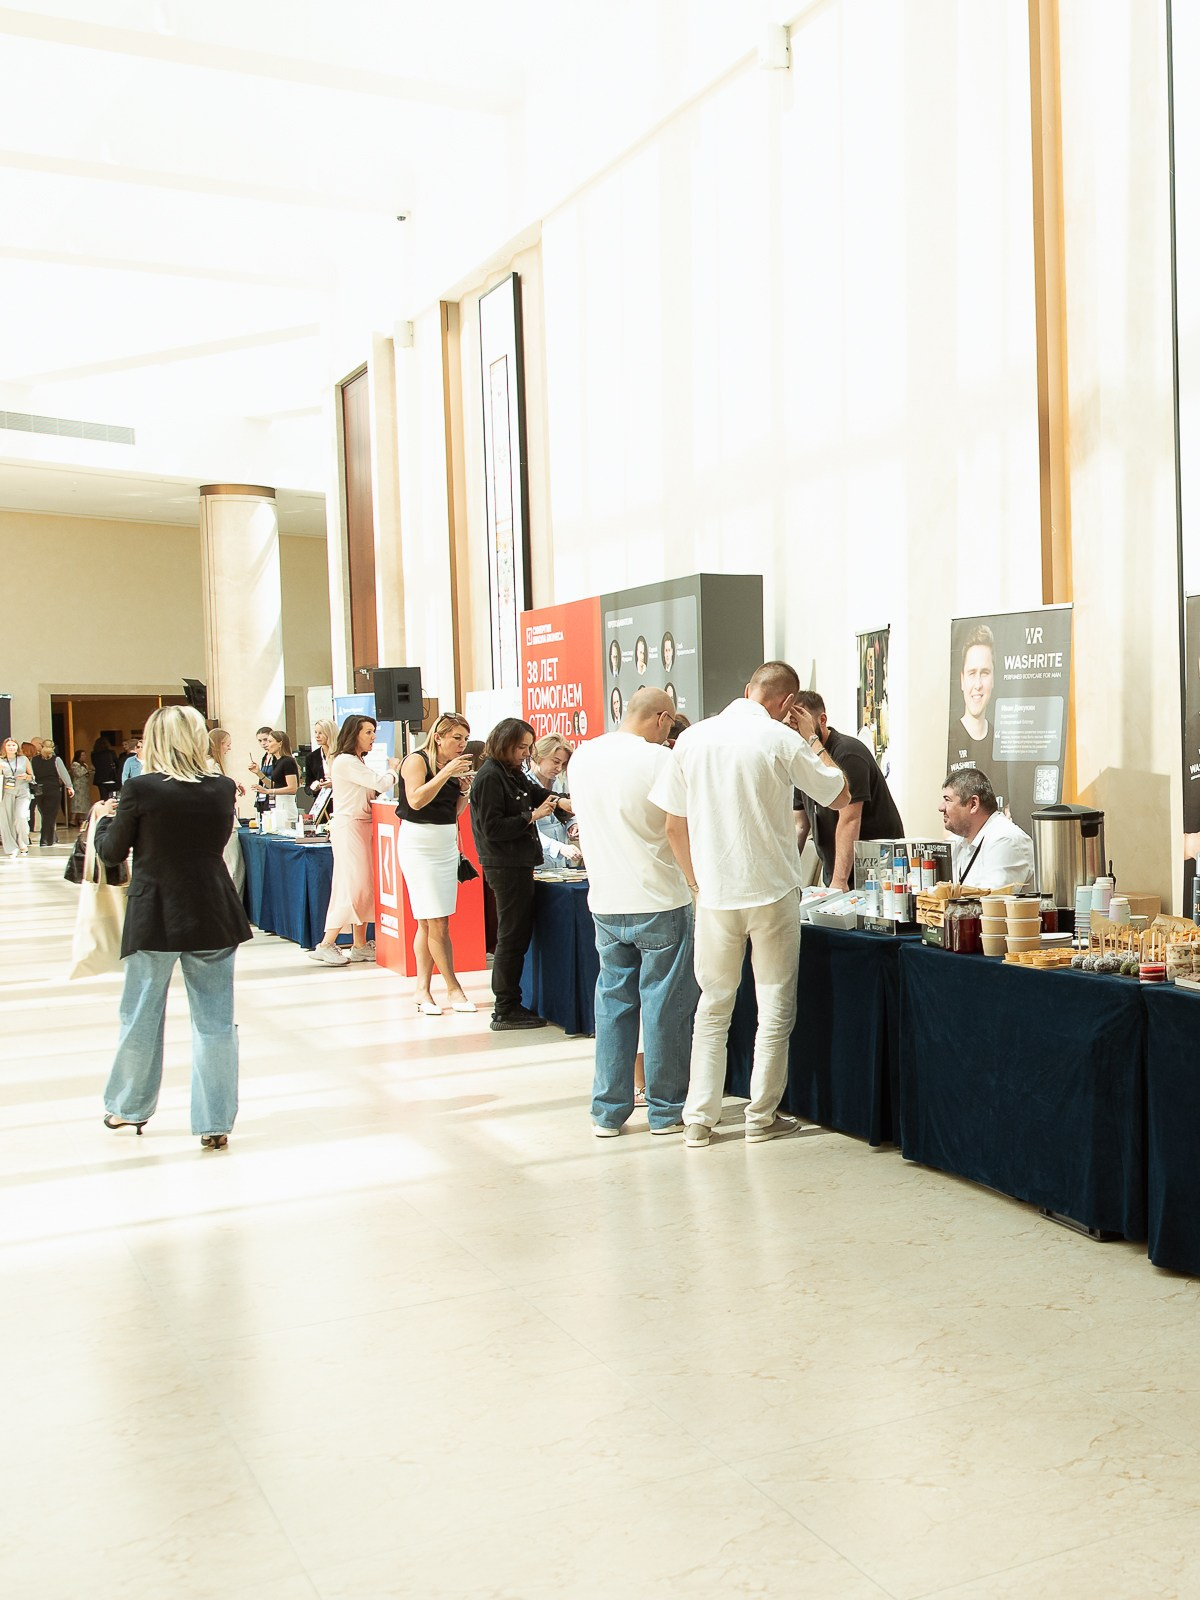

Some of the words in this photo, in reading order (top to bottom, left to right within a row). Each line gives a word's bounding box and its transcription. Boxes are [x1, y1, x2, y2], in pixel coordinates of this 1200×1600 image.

[526, 660, 539, 683] 38
[539, 657, 559, 683] ЛЕТ
[1004, 652, 1063, 670] WASHRITE
[527, 683, 583, 710] ПОМОГАЕМ
[529, 712, 572, 737] СТРОИТЬ
